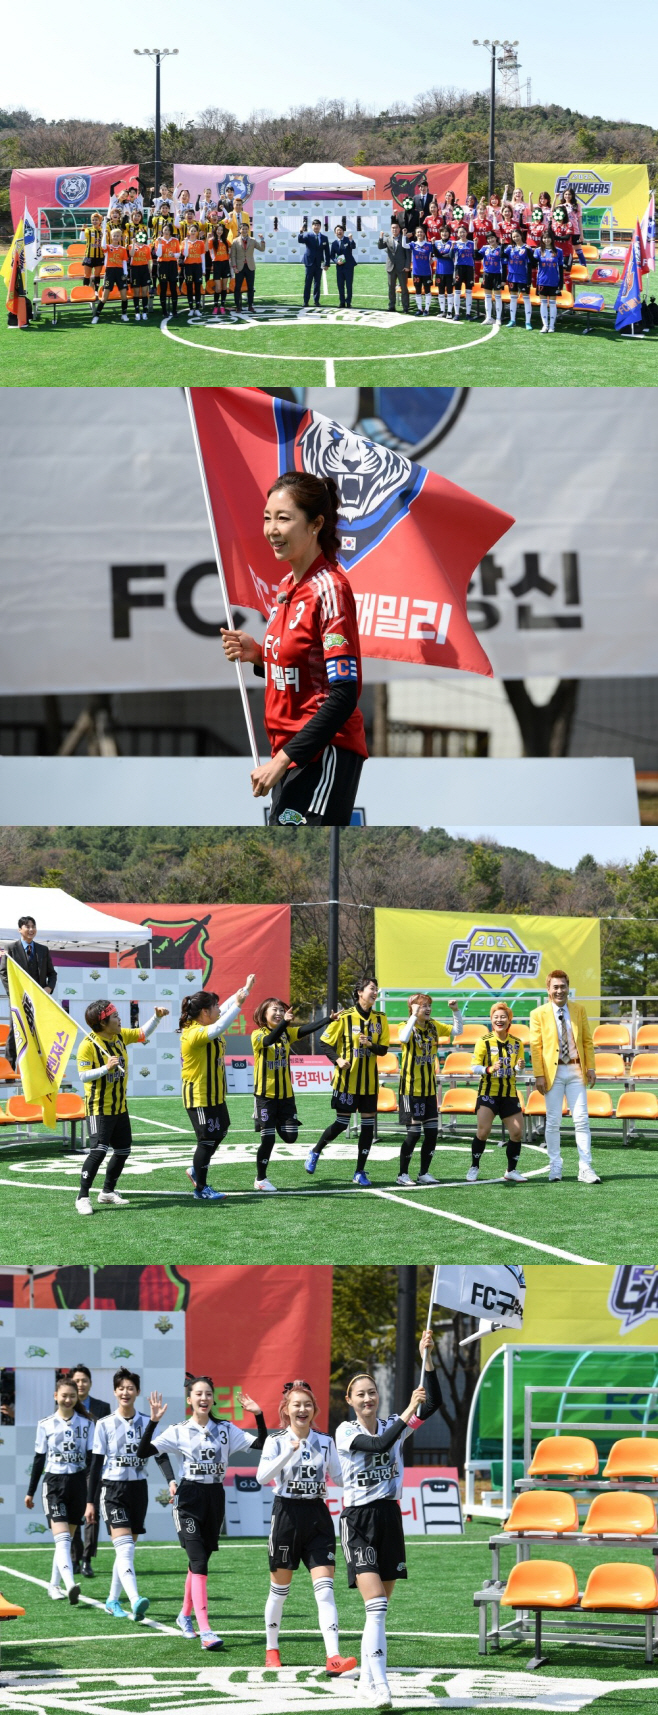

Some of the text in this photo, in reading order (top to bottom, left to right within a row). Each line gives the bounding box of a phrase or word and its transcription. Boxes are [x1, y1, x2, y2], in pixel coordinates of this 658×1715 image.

[288, 600, 306, 631] 3
[263, 633, 281, 661] FC
[336, 659, 350, 677] C
[474, 935, 516, 949] 2021
[260, 1107, 270, 1122] 5
[207, 1117, 221, 1133] 34
[75, 1425, 89, 1439] 18
[219, 1430, 228, 1445] 3
[61, 1440, 77, 1452] FC
[123, 1442, 138, 1454] FC
[321, 1445, 328, 1462] 7
[199, 1448, 216, 1461] FC
[371, 1451, 391, 1467] FC
[299, 1464, 318, 1479] FC
[185, 1517, 196, 1534] 3
[279, 1545, 290, 1563] 7
[354, 1546, 377, 1567] 10
